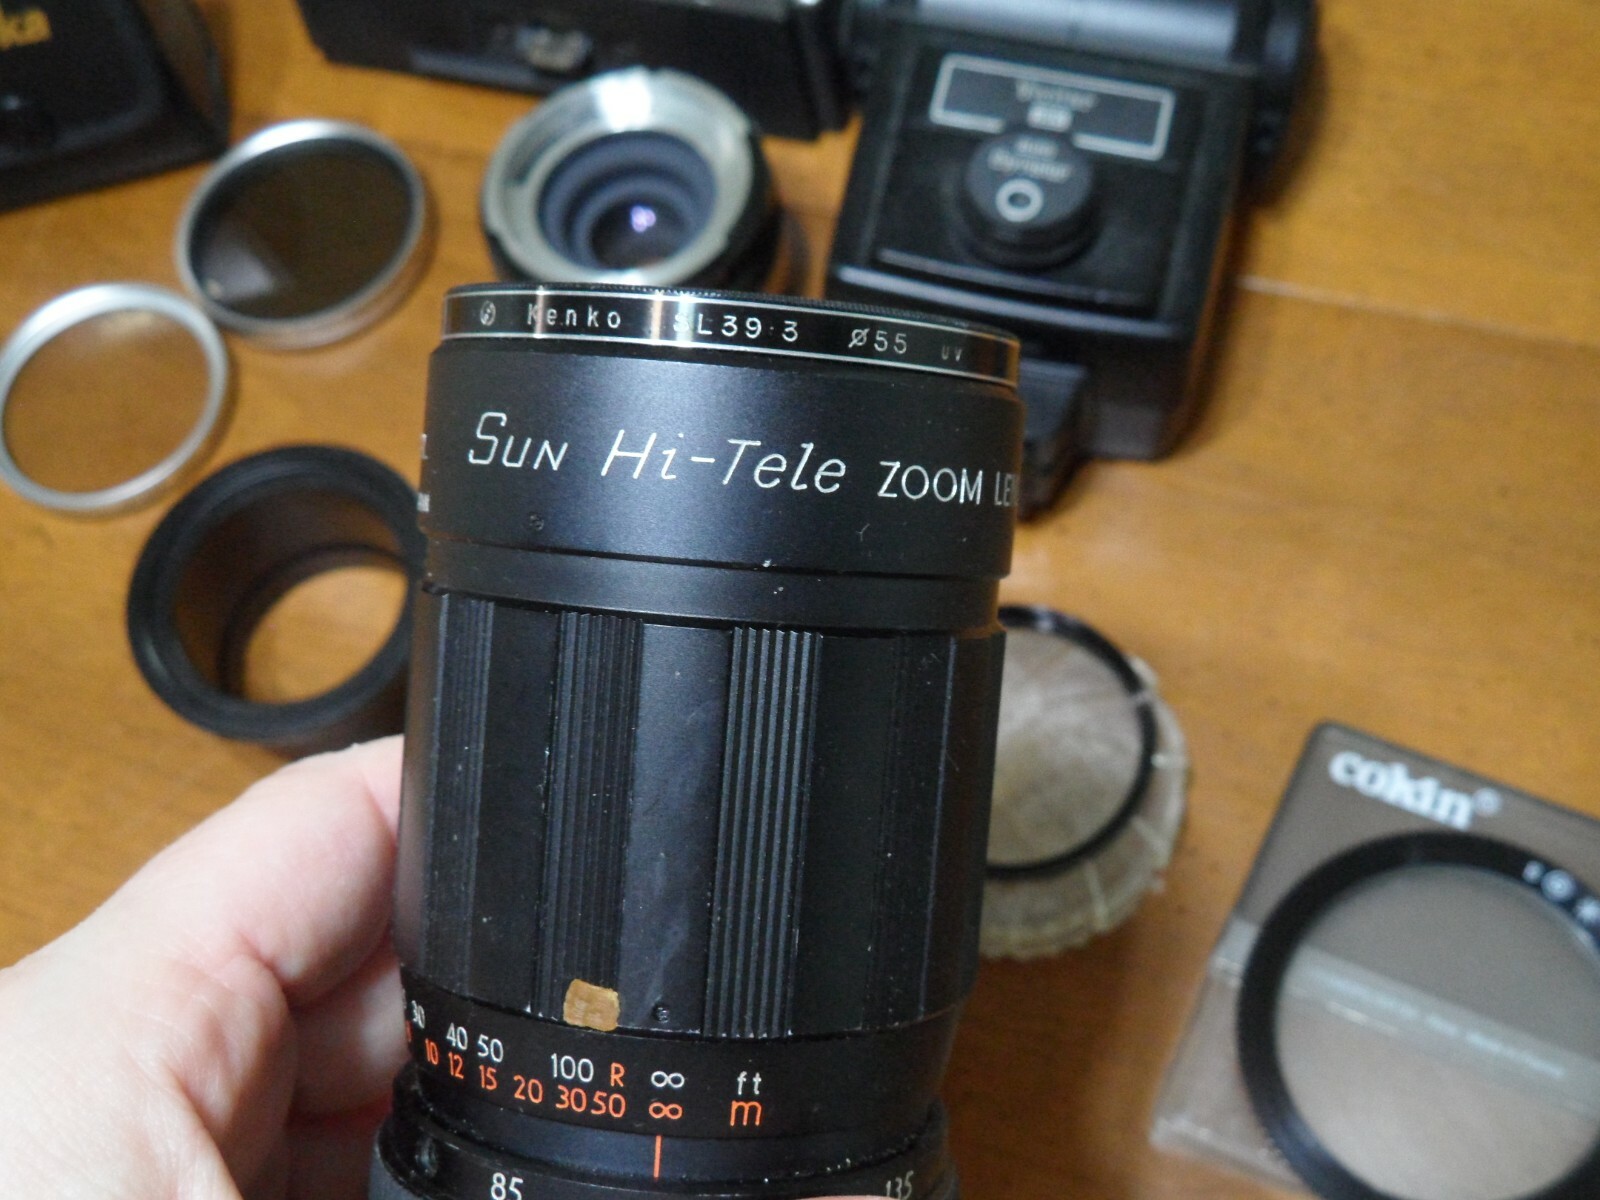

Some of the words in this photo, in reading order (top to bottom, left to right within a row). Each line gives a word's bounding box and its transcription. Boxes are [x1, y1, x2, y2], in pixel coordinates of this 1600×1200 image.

[527, 303, 622, 329] Kenko
[600, 428, 846, 493] Hi-Tele
[877, 461, 983, 505] ZOOM
[411, 1000, 425, 1029] 30
[446, 1022, 468, 1051] 40
[477, 1034, 504, 1063] 50
[550, 1052, 594, 1083] 100
[610, 1062, 625, 1088] R
[737, 1071, 762, 1096] ft
[425, 1038, 439, 1066] 10
[448, 1052, 464, 1080] 12
[479, 1064, 498, 1091] 15
[513, 1075, 543, 1104] 20
[555, 1085, 587, 1113] 30
[590, 1091, 626, 1118] 50
[730, 1100, 762, 1127] m
[490, 1172, 524, 1200] 85
